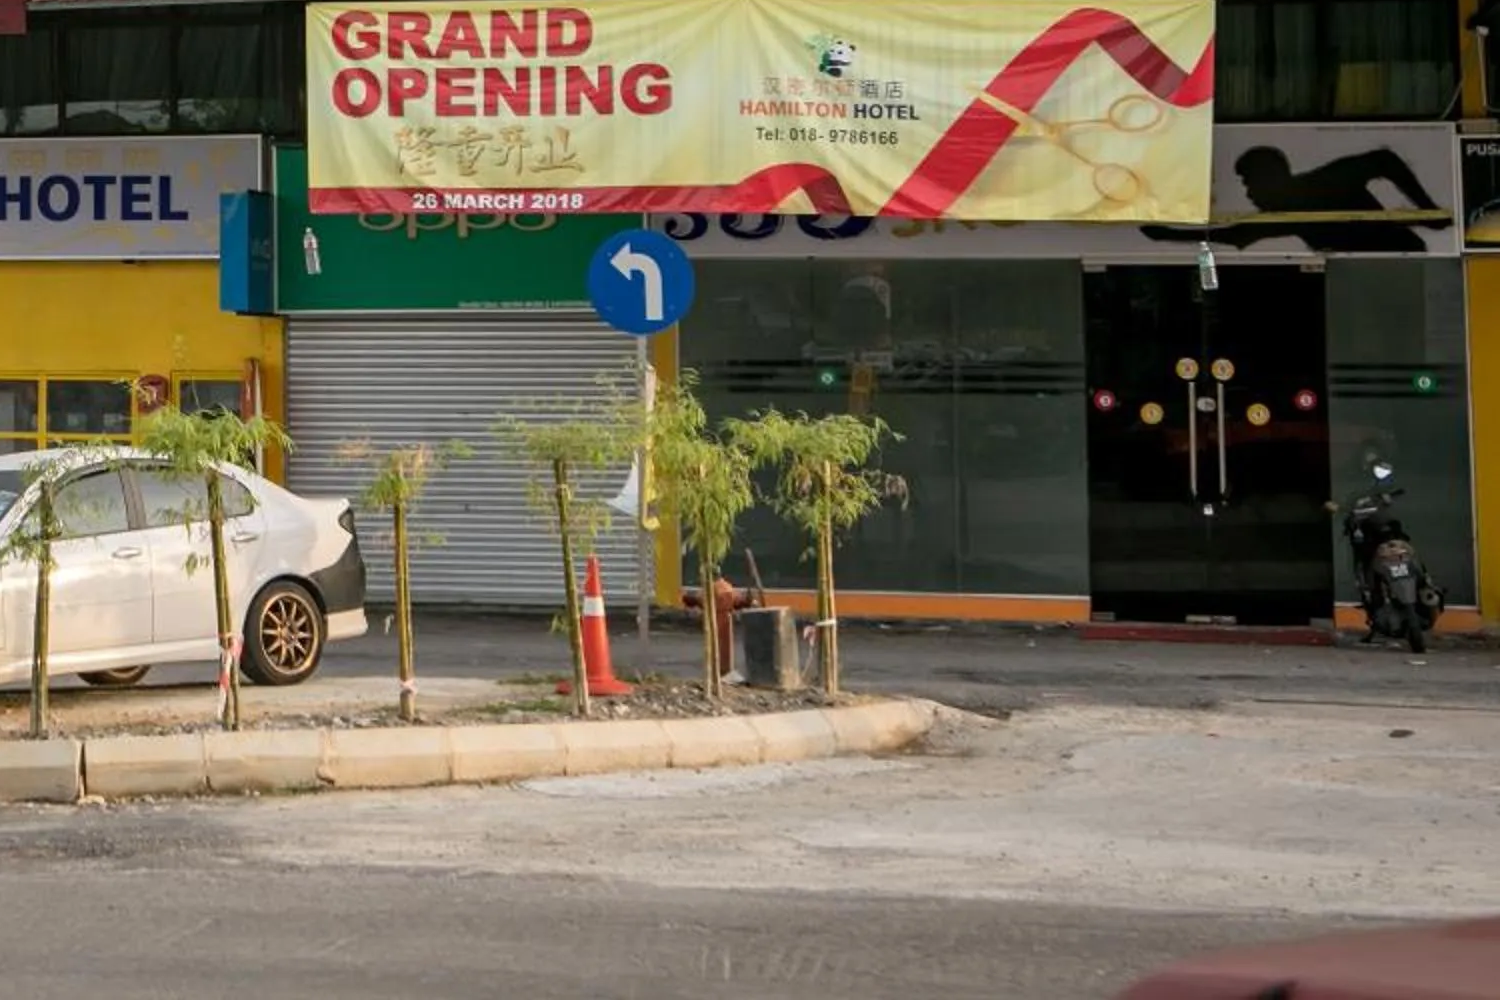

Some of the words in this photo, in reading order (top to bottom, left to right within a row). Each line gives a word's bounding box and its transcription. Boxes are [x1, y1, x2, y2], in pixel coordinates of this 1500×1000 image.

[331, 7, 593, 60] GRAND
[331, 62, 673, 118] OPENING
[739, 99, 847, 119] HAMILTON
[853, 103, 920, 121] HOTEL
[756, 127, 784, 141] Tel:
[412, 193, 437, 209] 26
[444, 193, 524, 209] MARCH
[531, 193, 583, 209] 2018
